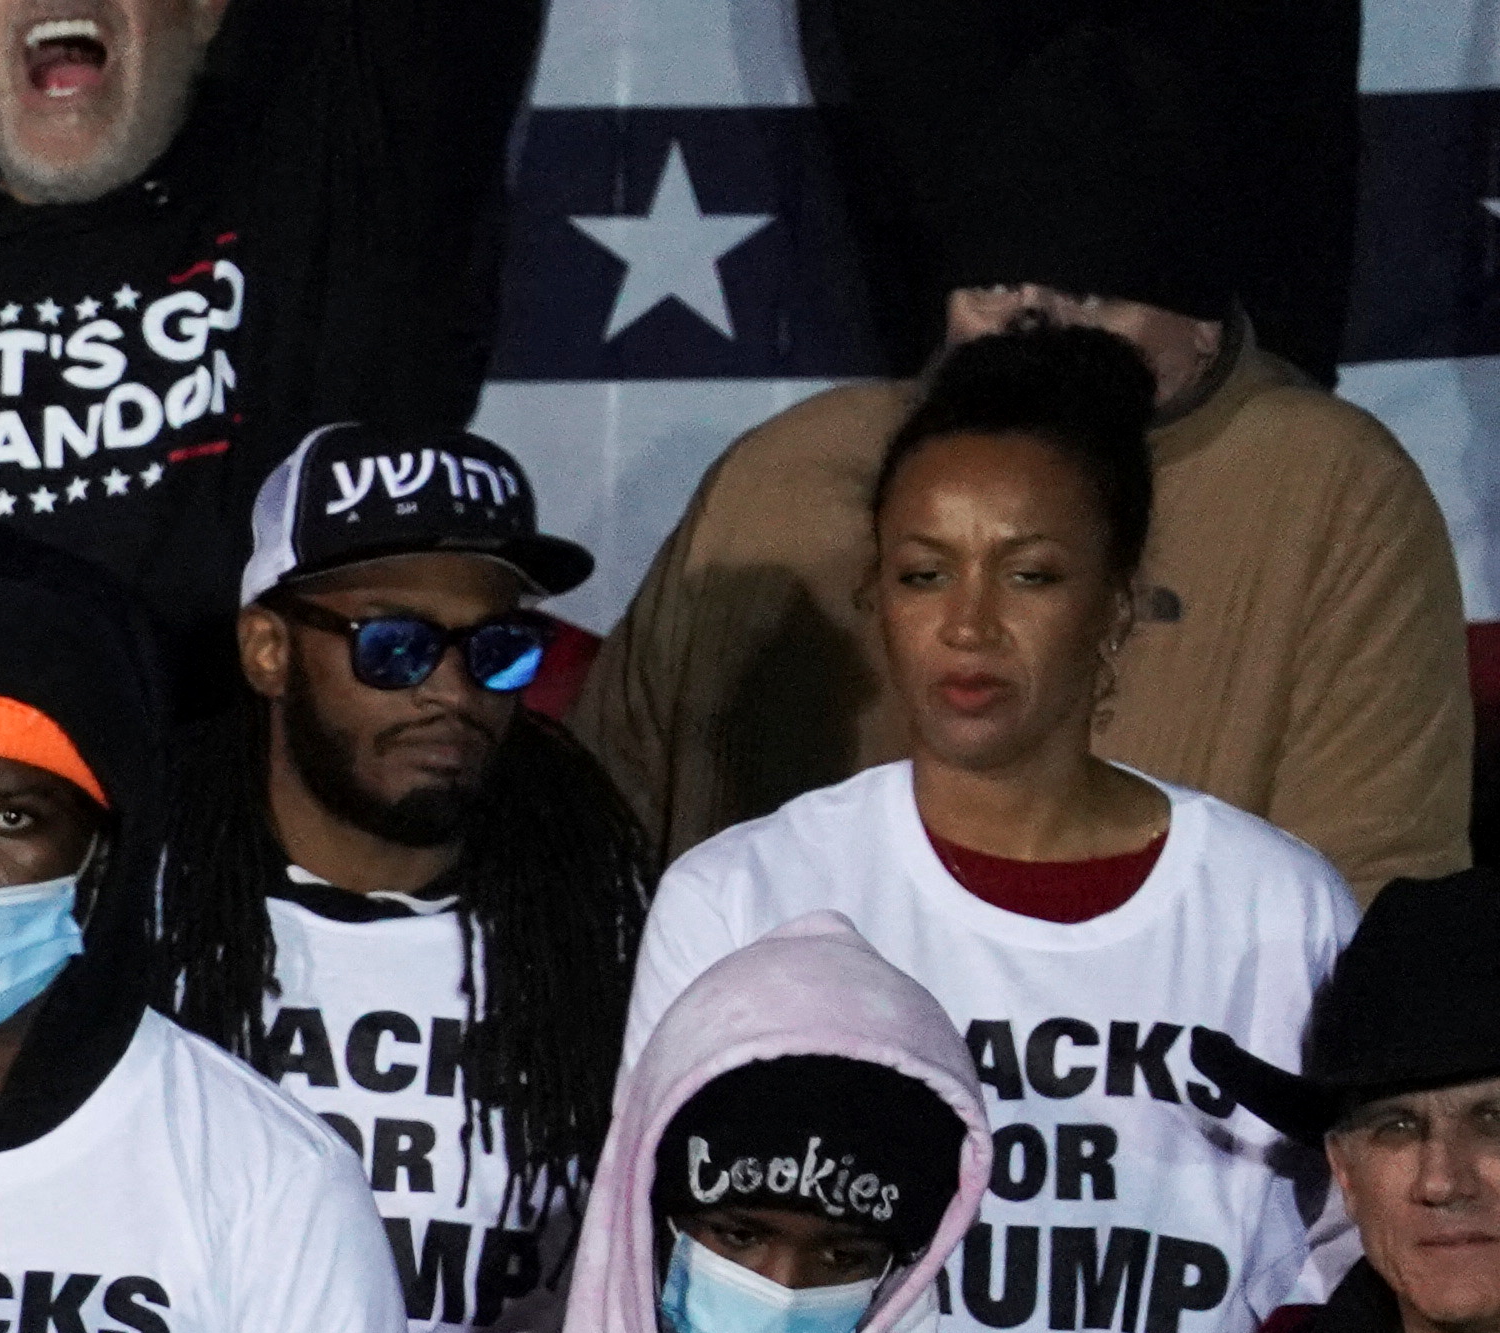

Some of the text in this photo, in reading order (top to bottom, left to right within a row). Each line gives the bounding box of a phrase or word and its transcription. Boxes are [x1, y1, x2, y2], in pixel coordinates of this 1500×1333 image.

[964, 1018, 1238, 1118] ACKS
[688, 1133, 900, 1222] Cookies
[990, 1122, 1117, 1202] OR
